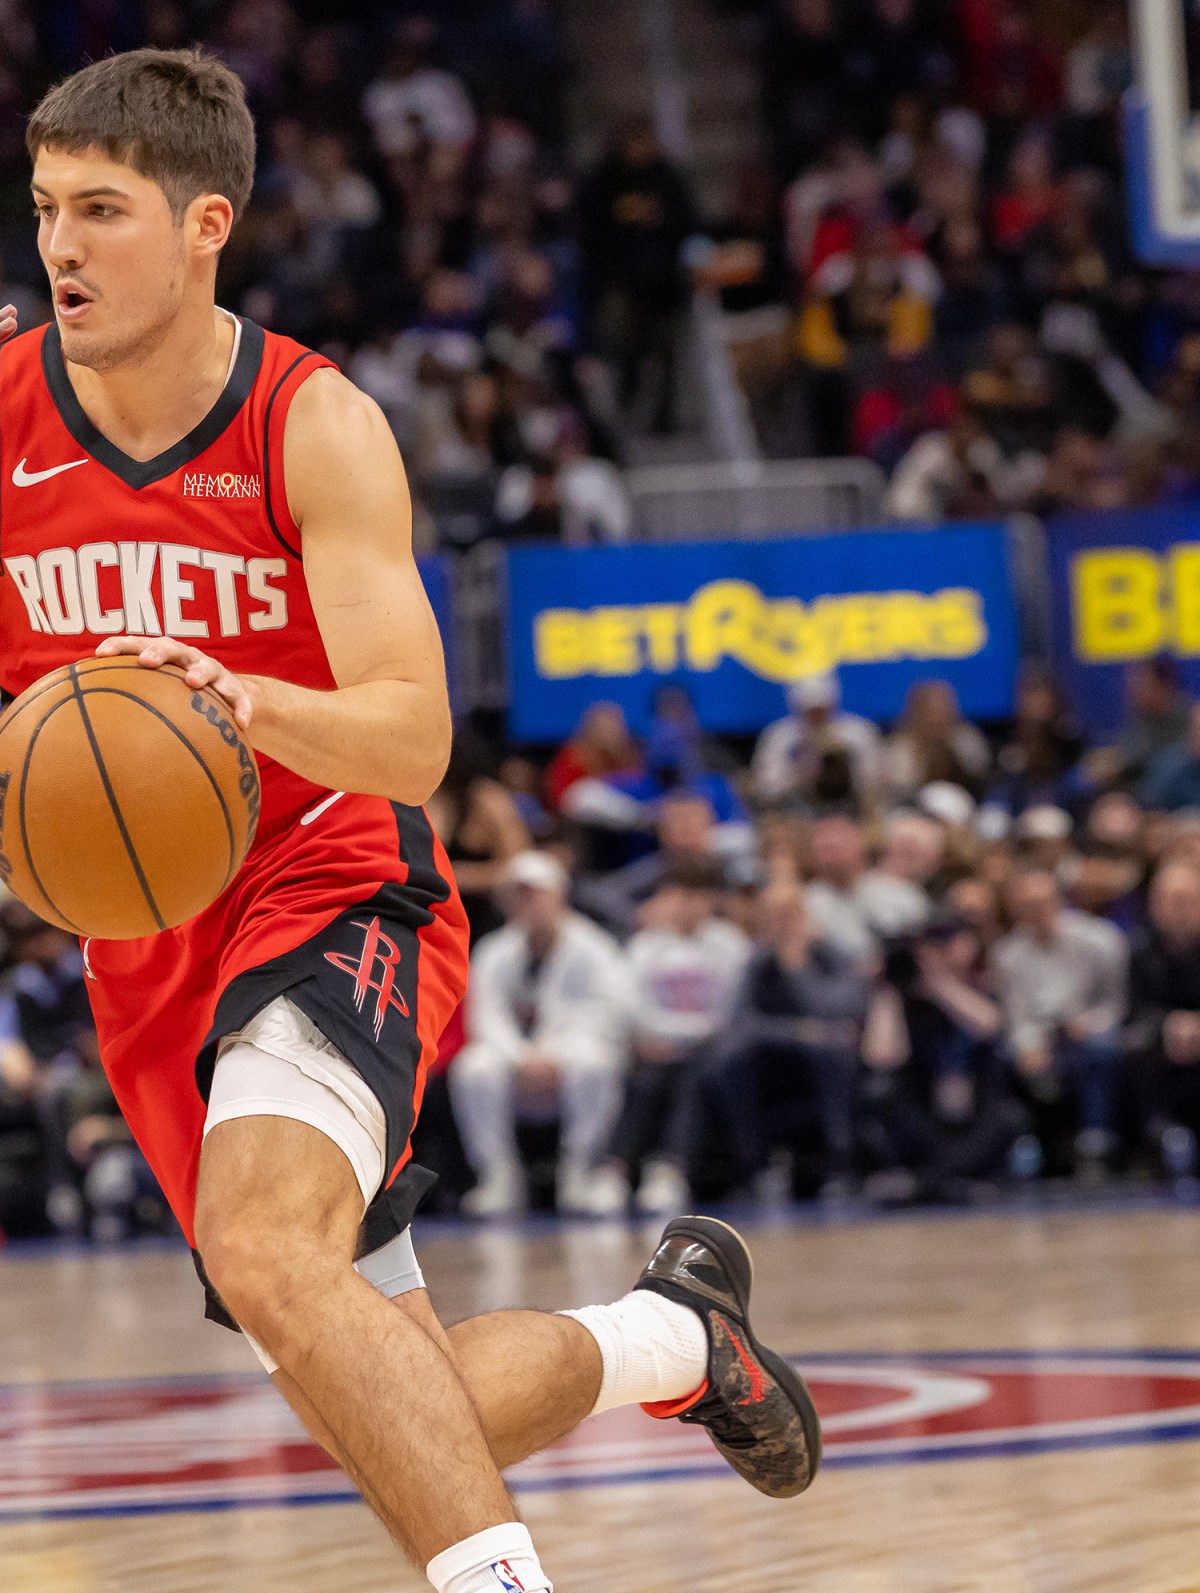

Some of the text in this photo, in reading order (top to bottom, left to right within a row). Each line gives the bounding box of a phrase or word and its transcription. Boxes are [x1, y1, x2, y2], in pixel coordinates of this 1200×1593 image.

[183, 472, 260, 487] MEMORIAL
[183, 483, 260, 498] HERMANN
[2, 541, 289, 638] ROCKETS
